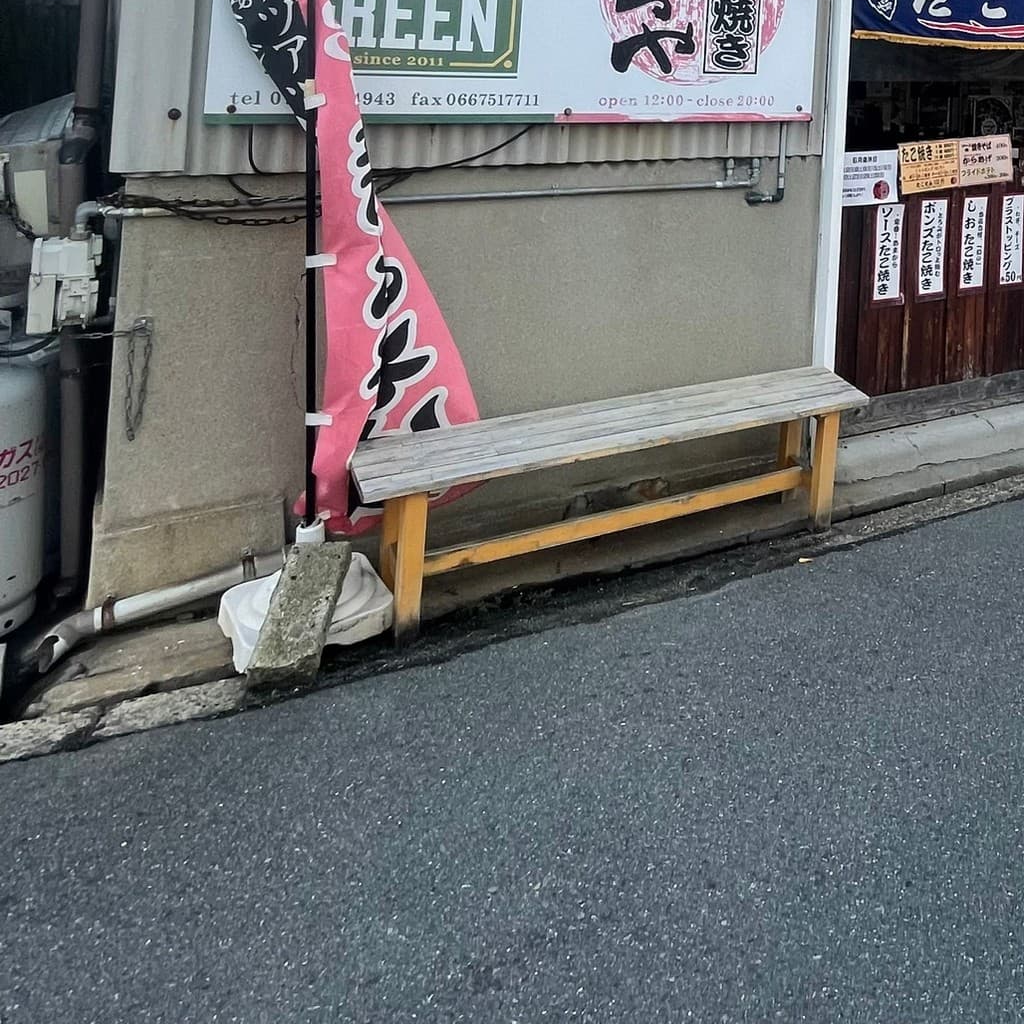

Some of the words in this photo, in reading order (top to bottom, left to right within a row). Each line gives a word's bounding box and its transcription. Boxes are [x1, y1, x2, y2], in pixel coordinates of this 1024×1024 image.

[353, 53, 402, 66] since
[407, 56, 445, 67] 2011
[230, 91, 261, 106] tel
[411, 92, 443, 107] fax
[446, 93, 541, 108] 0667517711
[598, 96, 638, 109] open
[737, 95, 775, 107] 20:00
[901, 144, 933, 163] たこ焼き
[962, 199, 977, 285] しおたこ焼き
[1002, 197, 1014, 271] プラストッピング
[877, 206, 894, 296] ソースたこ焼き
